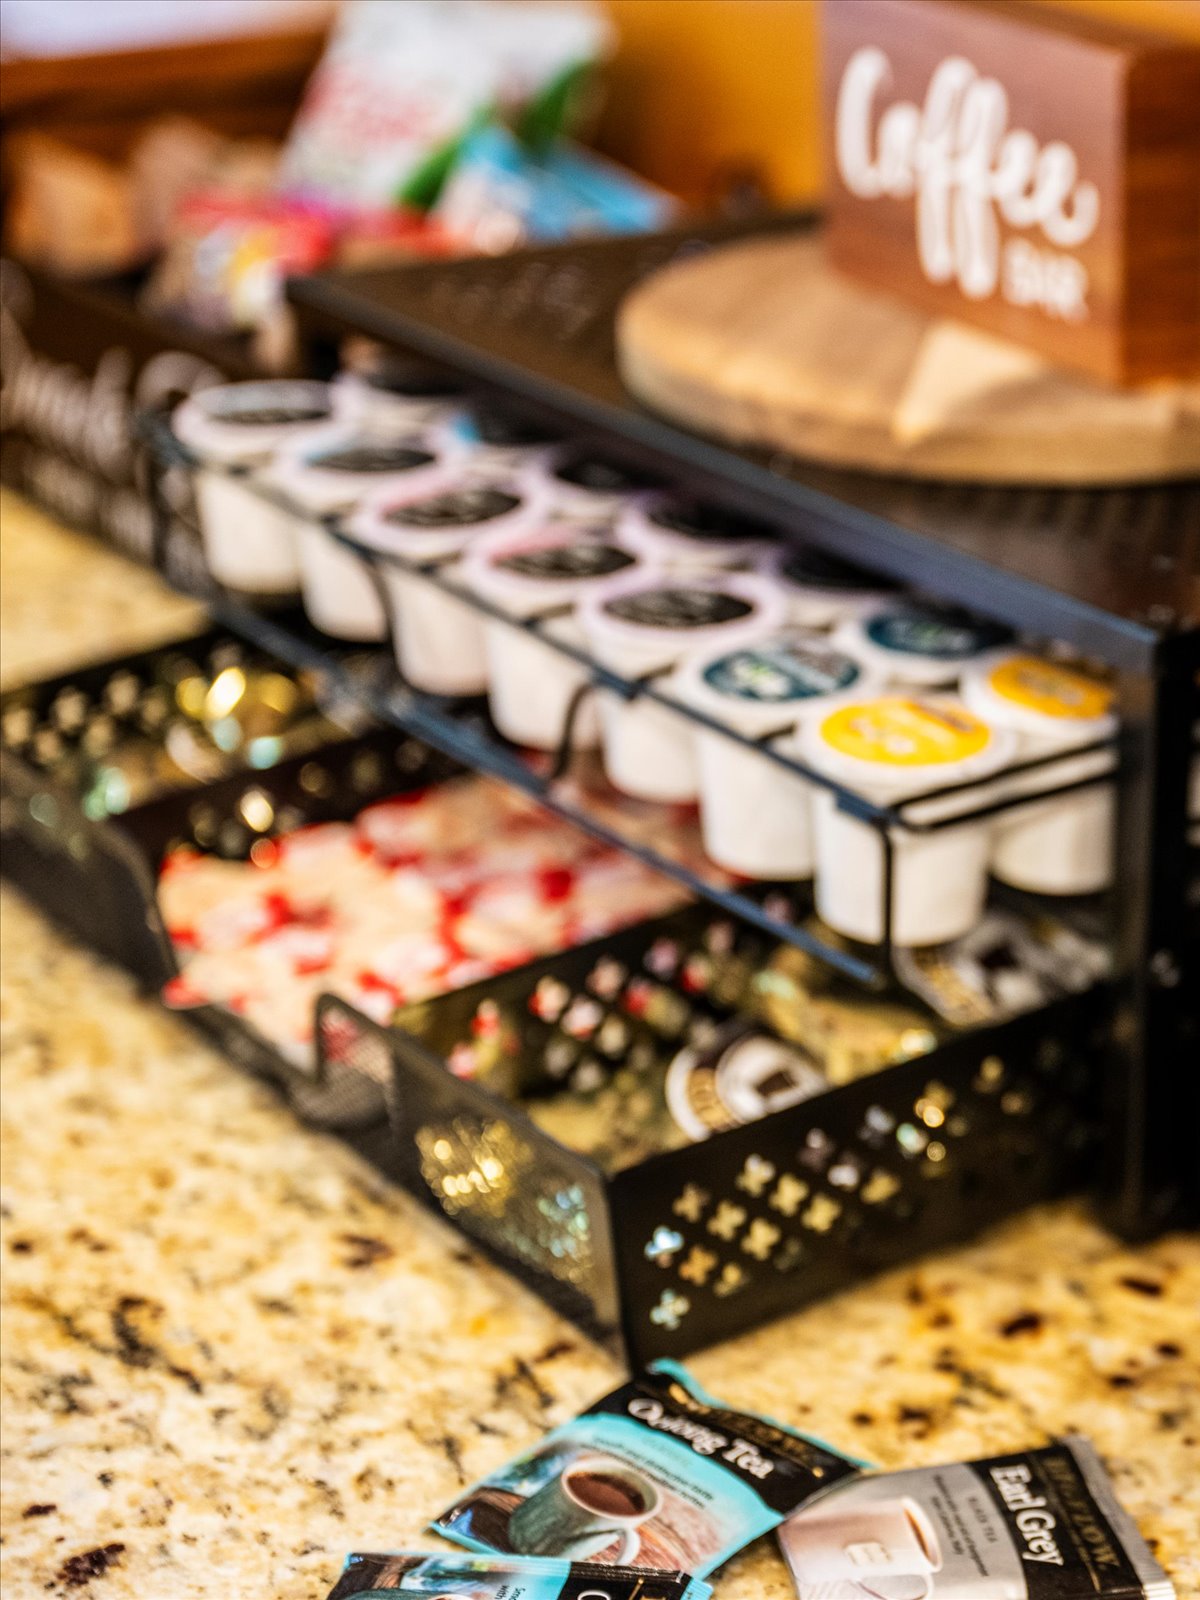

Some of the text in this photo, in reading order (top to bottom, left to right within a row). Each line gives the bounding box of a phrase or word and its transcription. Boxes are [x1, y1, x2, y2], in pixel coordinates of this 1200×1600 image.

[836, 45, 1100, 298] Coffee
[722, 1438, 774, 1479] Tea
[990, 1463, 1047, 1512] Earl
[1016, 1508, 1064, 1566] Grey
